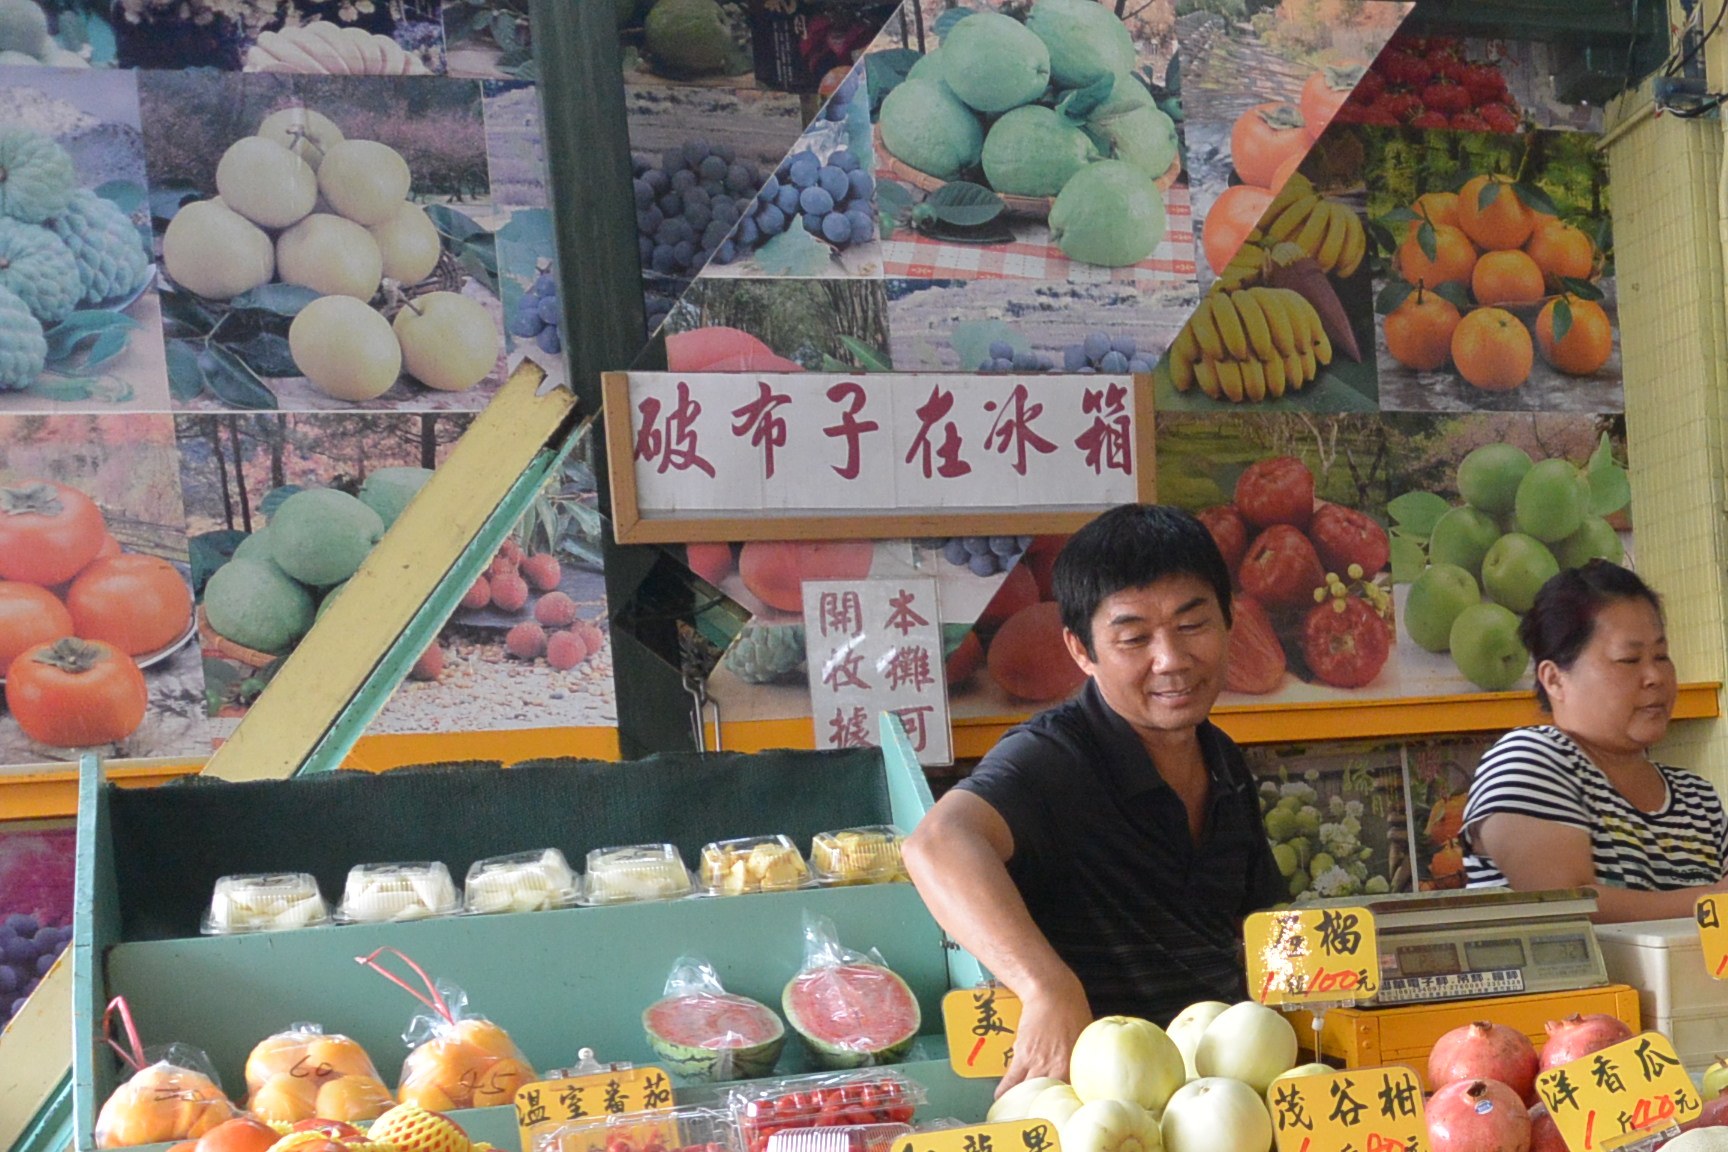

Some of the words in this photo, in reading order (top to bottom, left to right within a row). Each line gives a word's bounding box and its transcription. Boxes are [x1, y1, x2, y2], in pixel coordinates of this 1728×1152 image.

[634, 380, 1132, 480] 破布子在冰箱
[1273, 911, 1362, 957] 石榴
[1274, 1073, 1417, 1132] 茂谷柑
[1540, 1038, 1681, 1113] 洋香瓜
